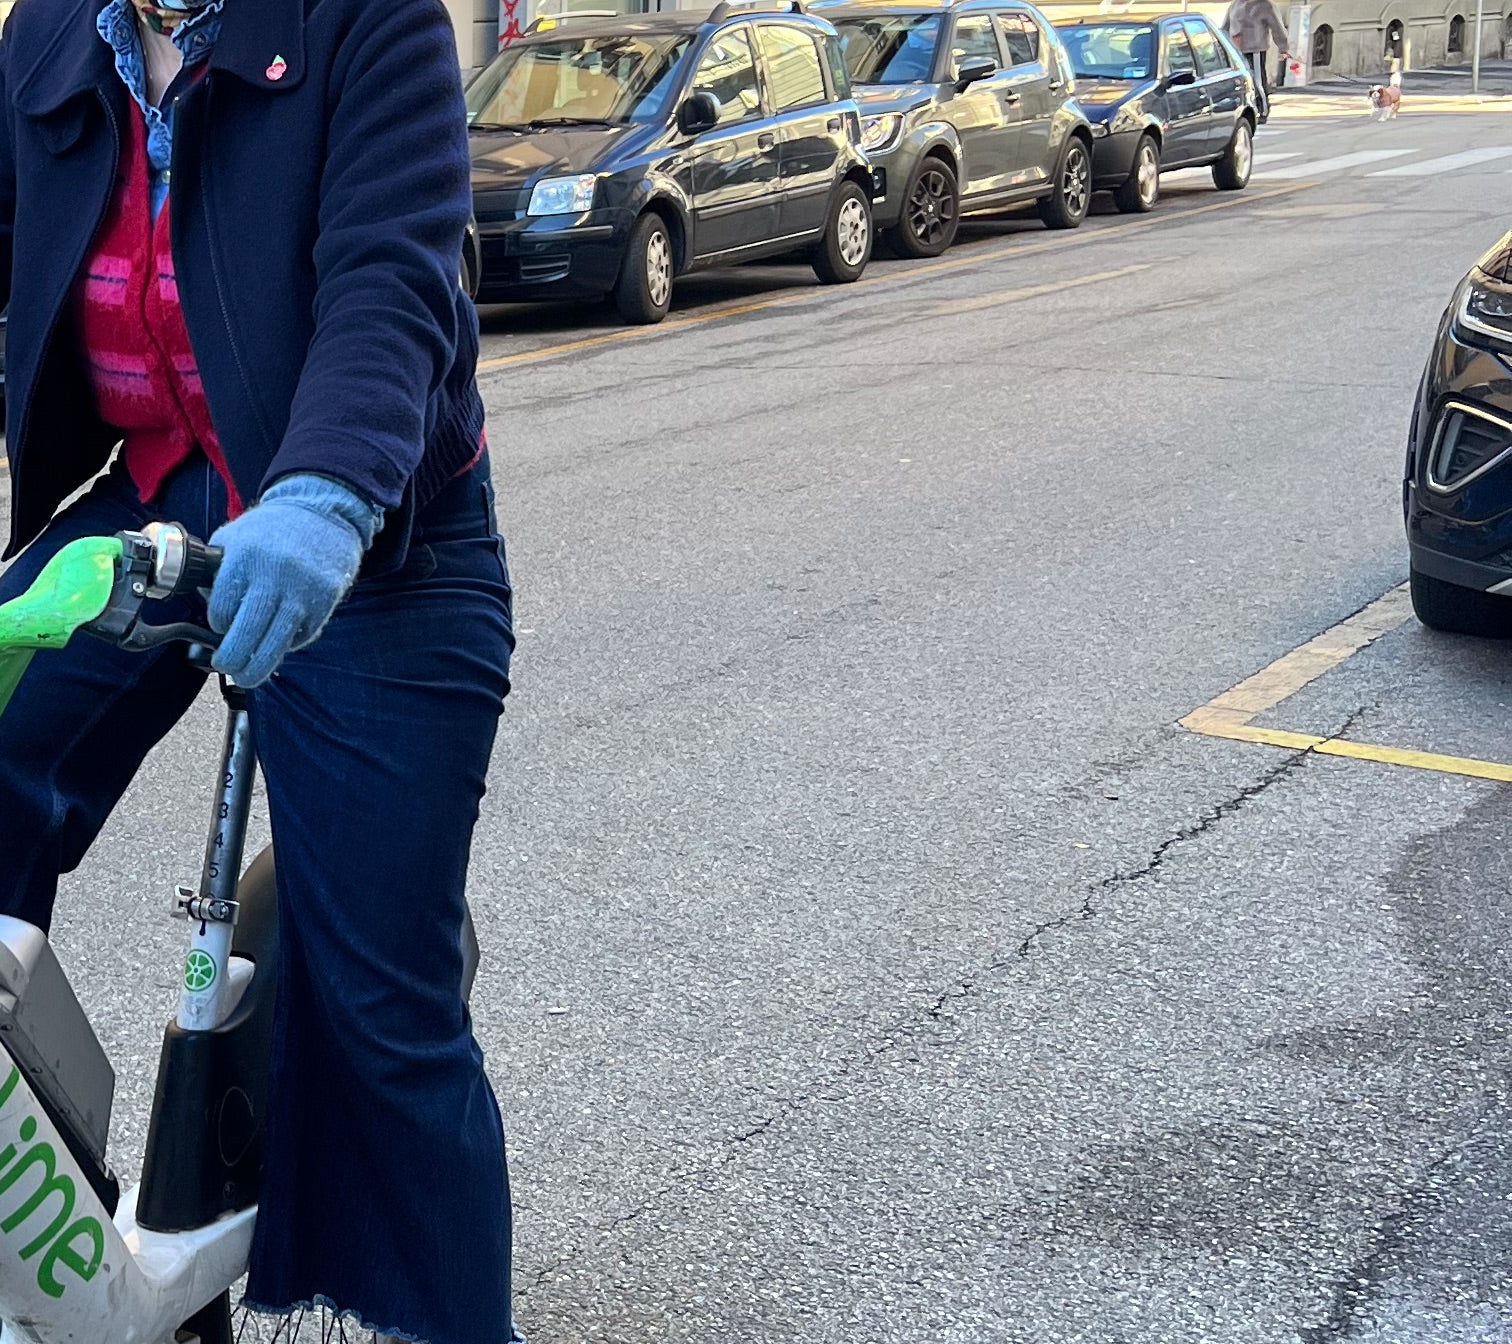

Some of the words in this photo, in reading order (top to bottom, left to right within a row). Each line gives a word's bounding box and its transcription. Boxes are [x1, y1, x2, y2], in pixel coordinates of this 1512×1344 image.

[229, 742, 235, 758] 1
[224, 772, 233, 788] 2
[219, 802, 229, 818] 3
[214, 832, 223, 848] 4
[209, 862, 219, 878] 5
